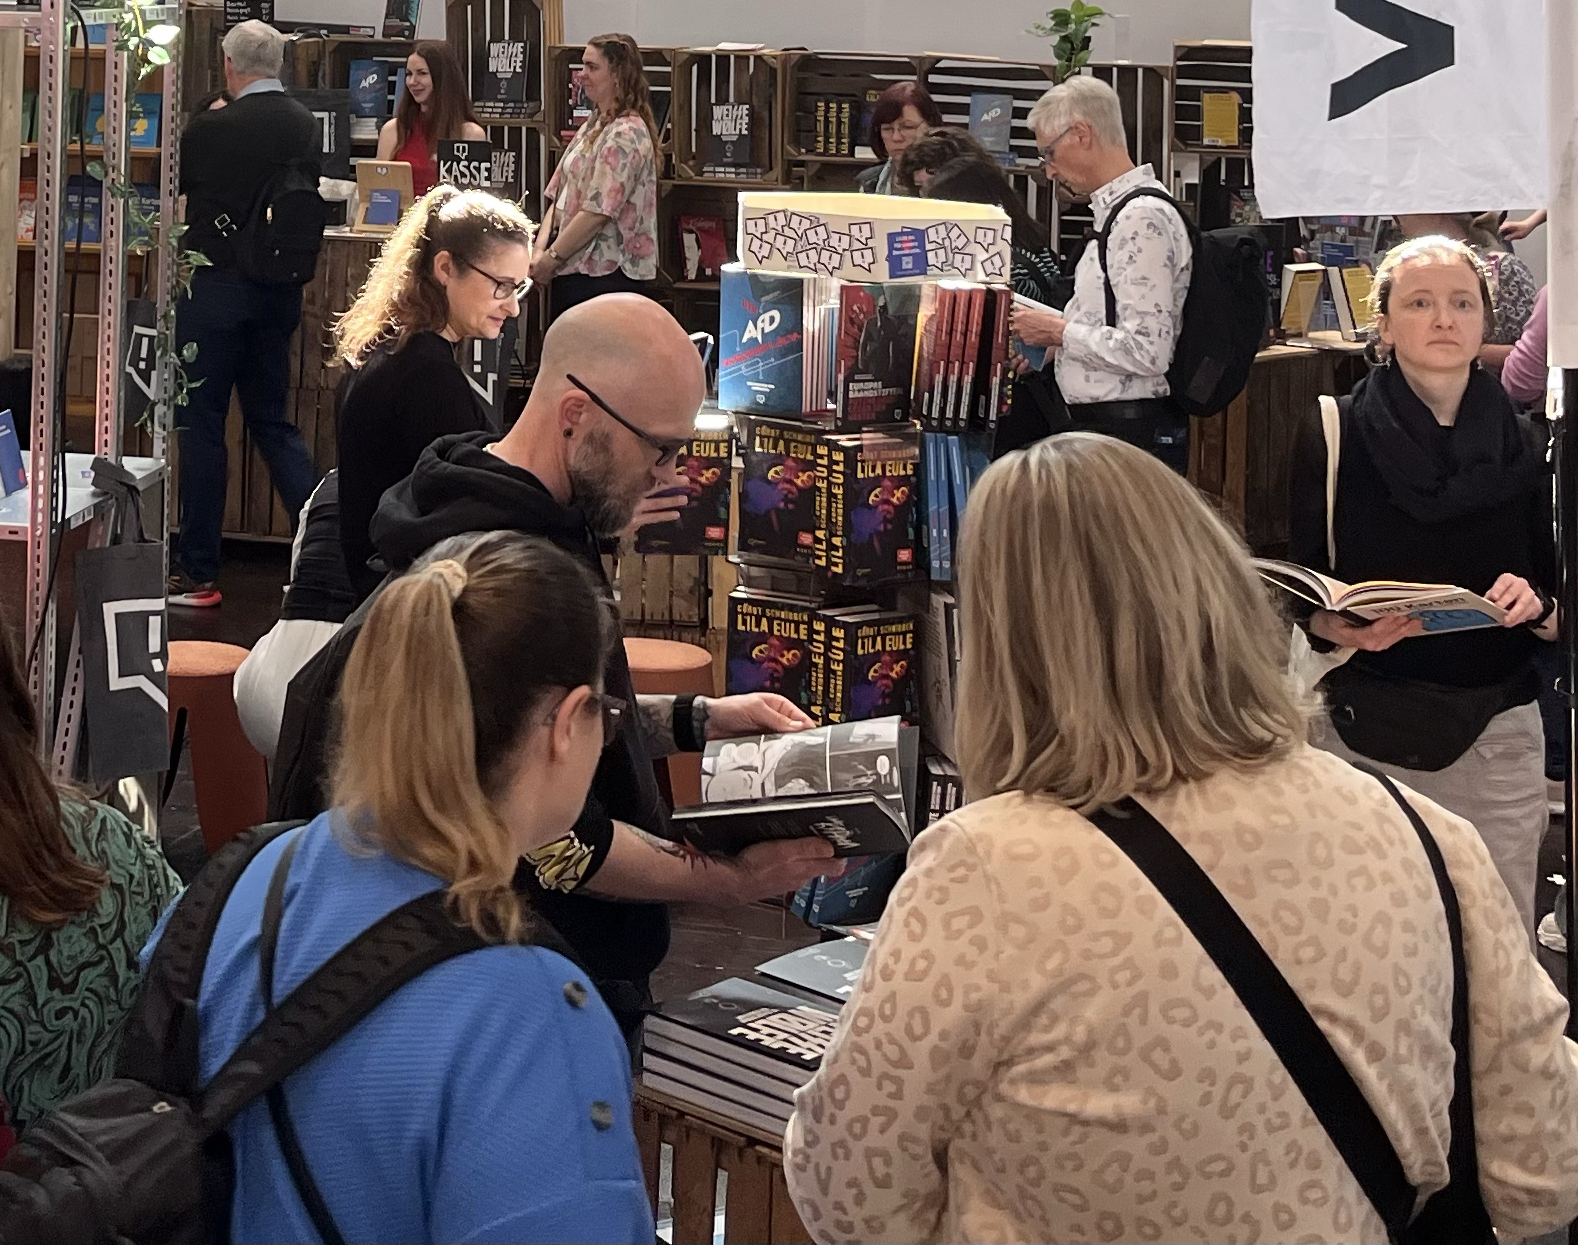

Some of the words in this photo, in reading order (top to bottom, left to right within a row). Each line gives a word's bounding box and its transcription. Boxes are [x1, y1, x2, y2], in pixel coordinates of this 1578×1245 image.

[439, 159, 491, 188] KASSE
[741, 308, 781, 344] AfD
[692, 441, 728, 458] EULE
[755, 436, 786, 455] LILA
[816, 444, 828, 491] EULE
[830, 450, 845, 498] EULE
[856, 462, 883, 479] LILA
[886, 459, 914, 477] EULE
[814, 529, 827, 567] LILA
[830, 536, 844, 574] LILA
[736, 614, 769, 633] LILA
[773, 620, 808, 640] EULE
[811, 620, 825, 665] EULE
[857, 636, 882, 656] LILA
[885, 633, 913, 652] EULE
[830, 626, 845, 670] EULE
